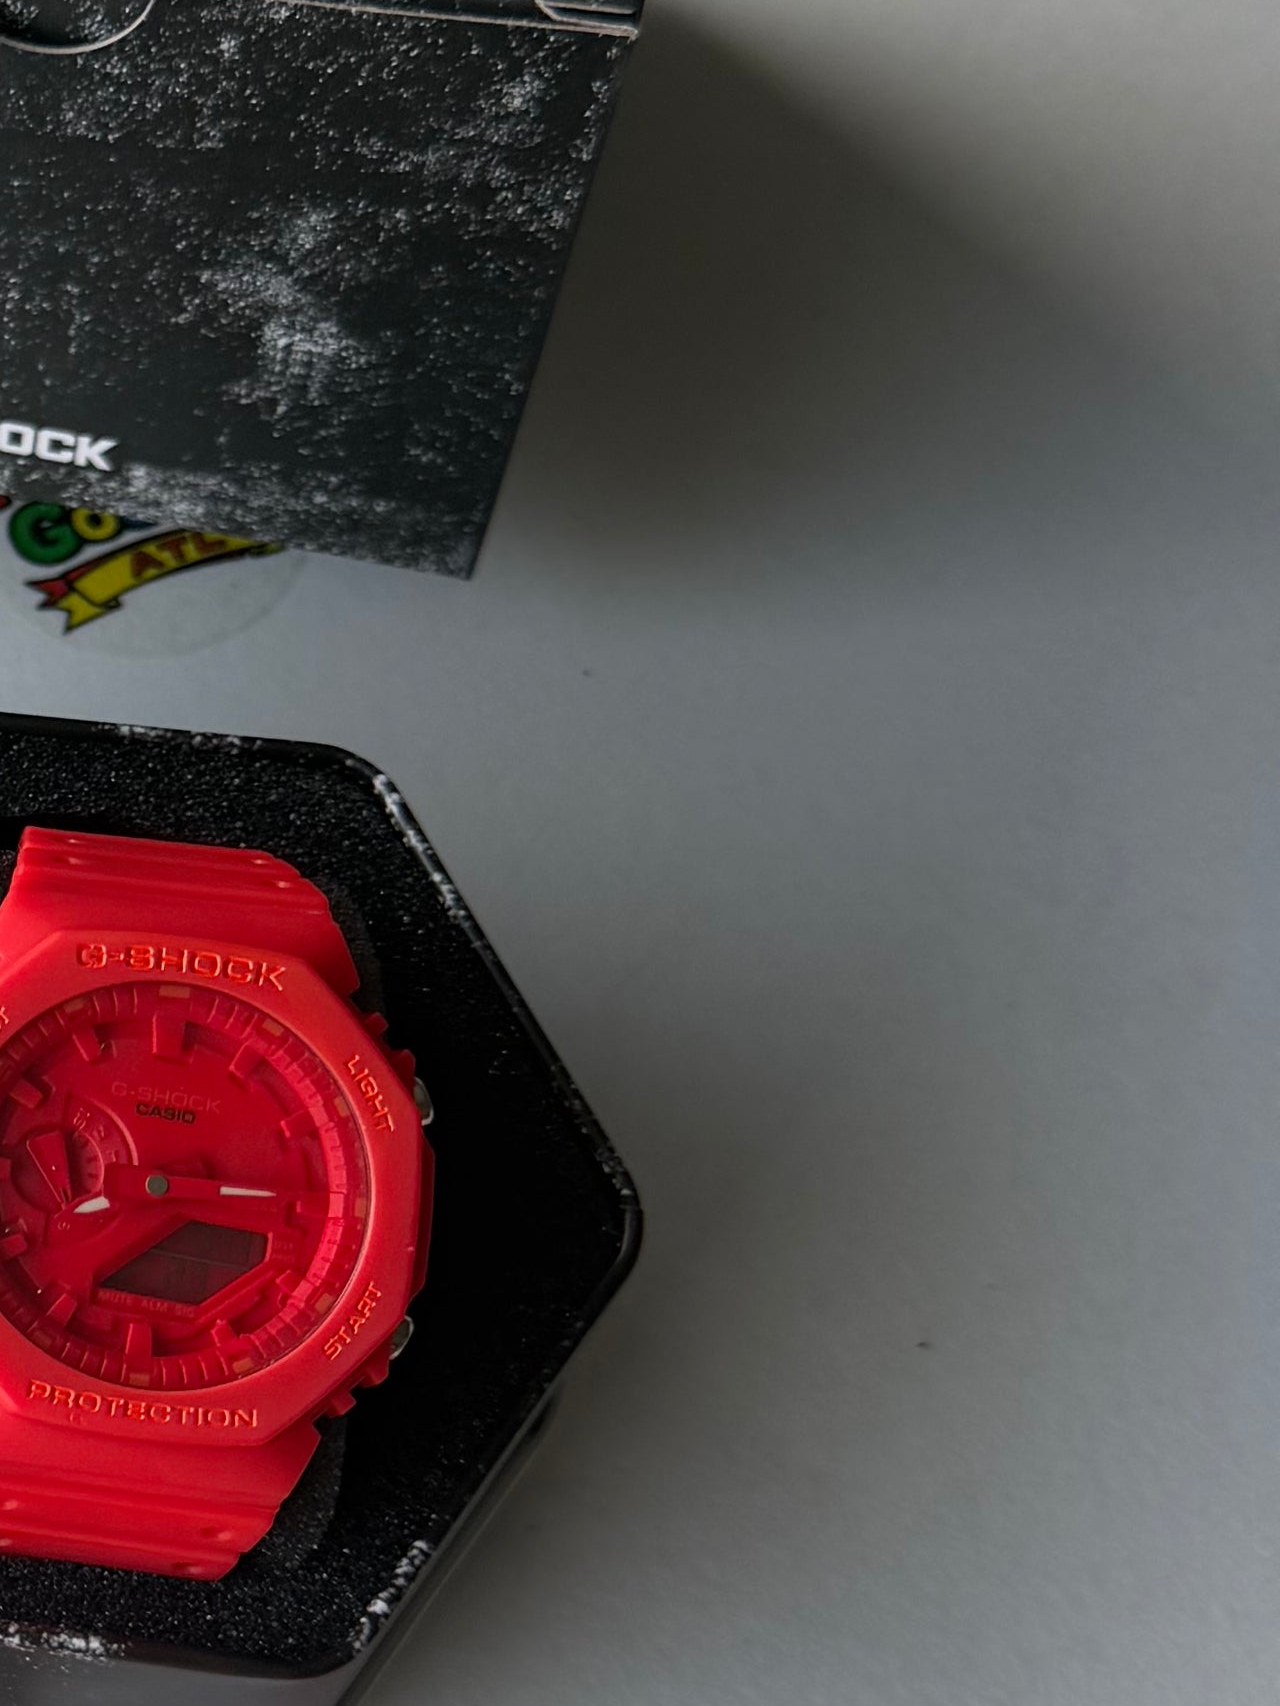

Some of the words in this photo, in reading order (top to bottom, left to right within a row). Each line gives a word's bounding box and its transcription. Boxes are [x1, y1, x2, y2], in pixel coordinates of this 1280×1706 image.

[76, 943, 287, 992] G-SHOCK
[134, 1101, 197, 1126] CASIO
[323, 1280, 383, 1361] START
[24, 1378, 260, 1429] PROTECTION
